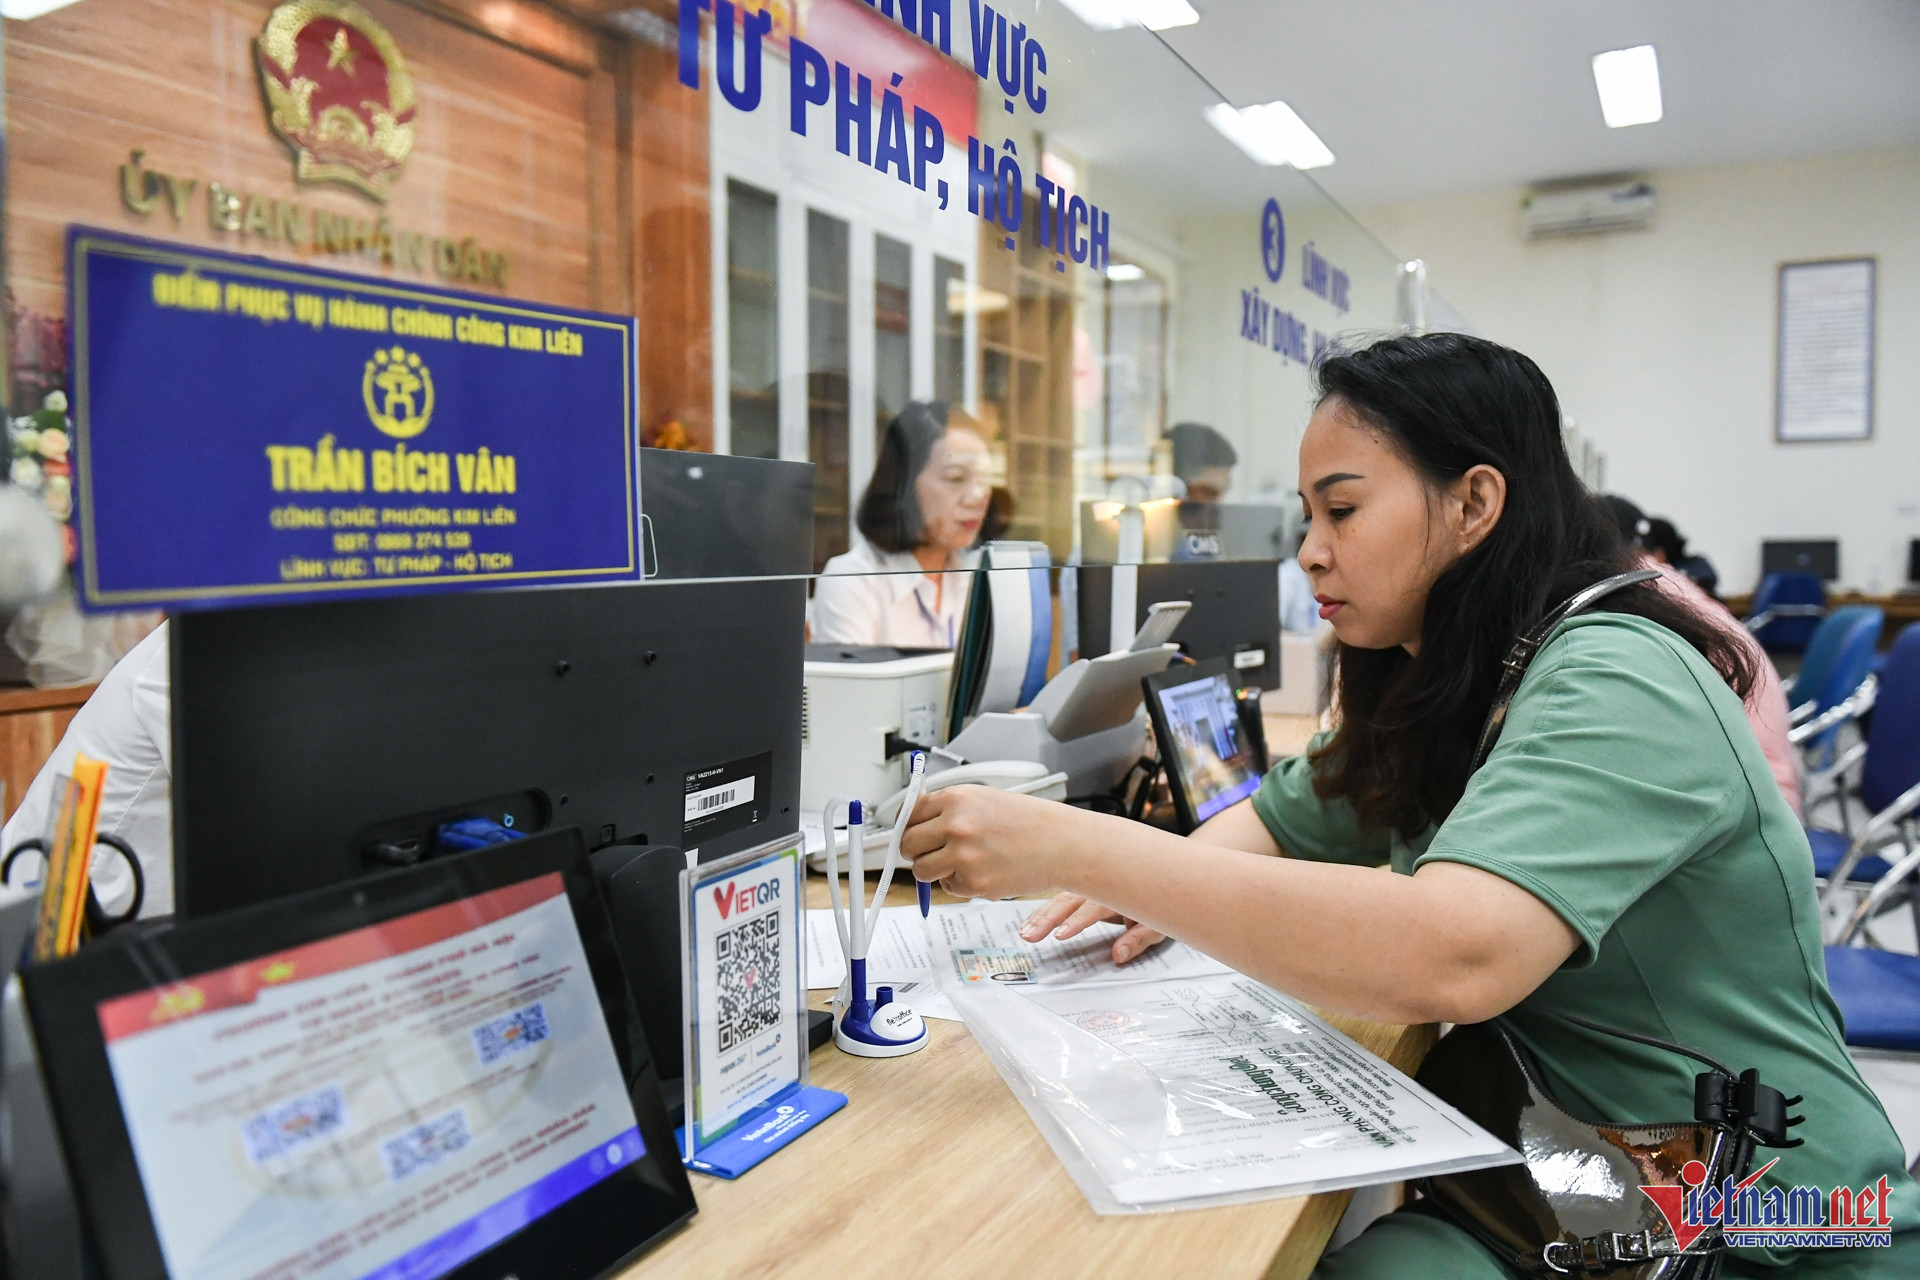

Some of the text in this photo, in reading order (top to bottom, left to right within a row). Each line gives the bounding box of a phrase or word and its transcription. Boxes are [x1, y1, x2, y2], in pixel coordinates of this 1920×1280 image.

[969, 0, 1047, 114] VỰC
[678, 0, 772, 112] TƯ
[789, 36, 949, 211] PHÁP,
[967, 138, 1023, 252] HỘ
[1035, 172, 1110, 273] TỊCH
[119, 149, 511, 288] ỦY BAN NHÂN DÂN
[455, 313, 507, 348] CÔNG
[507, 323, 544, 352] KIM
[545, 326, 583, 356] LIÊN
[371, 441, 451, 493] BÍCH
[456, 445, 516, 494] VÂN
[1306, 1084, 1340, 1106] CÔNG
